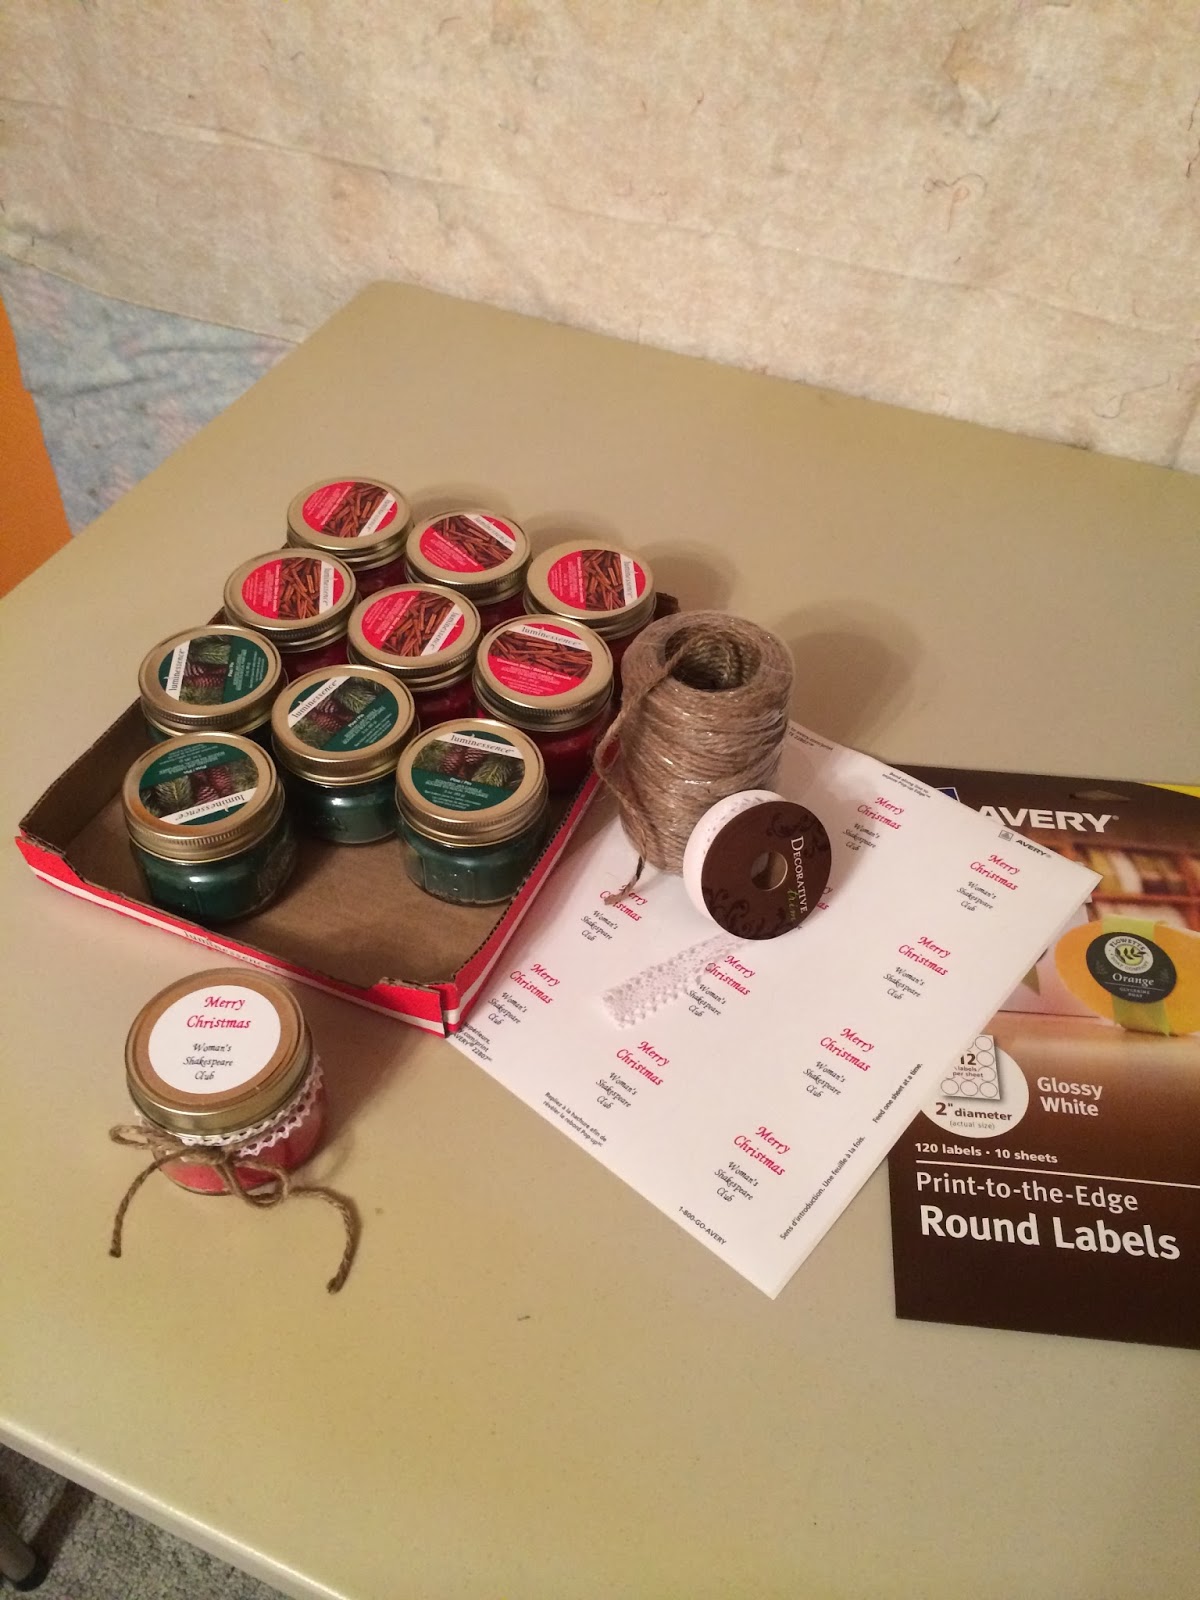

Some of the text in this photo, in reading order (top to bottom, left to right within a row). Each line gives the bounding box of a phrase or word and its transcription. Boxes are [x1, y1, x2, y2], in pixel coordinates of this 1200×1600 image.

[168, 648, 186, 691] luminessence
[291, 679, 337, 718] luminessence
[450, 734, 514, 753] luminessence
[874, 796, 905, 815] Merry
[857, 804, 902, 830] Christmas
[842, 828, 877, 849] Shakespeare
[853, 823, 880, 839] Woman's
[845, 841, 861, 851] Club
[988, 854, 1020, 875] Merry
[970, 861, 1018, 891] Christmas
[956, 887, 994, 910] Shakespeare
[967, 881, 997, 899] Woman's
[960, 900, 976, 912] Club
[580, 915, 613, 941] Shakespeare
[593, 910, 618, 930] Woman's
[581, 929, 596, 942] Club
[917, 936, 951, 958] Merry
[724, 955, 756, 979] Merry
[898, 944, 948, 976] Christmas
[530, 963, 560, 987] Merry
[704, 962, 751, 996] Christmas
[883, 973, 921, 998] Shakespeare
[895, 966, 925, 986] Woman's
[1112, 972, 1155, 987] Orange
[509, 970, 554, 1005] Christmas
[699, 984, 727, 1005] Woman's
[887, 988, 904, 1000] Club
[204, 996, 245, 1011] Merry
[487, 998, 521, 1025] Shakespeare
[501, 992, 528, 1014] Woman's
[686, 990, 722, 1016] Shakespeare
[688, 1004, 703, 1017] Club
[186, 1015, 251, 1029] Christmas
[488, 1012, 504, 1025] Club
[193, 1043, 232, 1052] Woman's
[840, 1028, 875, 1052] Merry
[182, 1057, 233, 1067] Shakespeare
[637, 1041, 670, 1067] Merry
[820, 1037, 871, 1072] Christmas
[194, 1070, 215, 1081] Club
[616, 1048, 664, 1086] Christmas
[815, 1061, 846, 1083] Woman's
[609, 1072, 638, 1096] Woman's
[802, 1068, 842, 1096] Shakespeare
[806, 1084, 824, 1098] Club
[1036, 1076, 1103, 1100] Glossy
[595, 1079, 632, 1109] Shakespeare
[596, 1095, 614, 1110] Club
[872, 1108, 886, 1124] Feed
[883, 1099, 894, 1111] one
[891, 1085, 905, 1100] sheet
[902, 1078, 910, 1086] at
[909, 1063, 923, 1076] time.
[954, 1108, 1013, 1121] diameter
[1040, 1096, 1100, 1117] White
[589, 1127, 600, 1136] afin
[949, 1120, 996, 1130] (actual size)
[755, 1126, 790, 1154] Merry
[734, 1135, 786, 1176] Christmas
[915, 1142, 1059, 1164] 120 labels 10 sheets
[714, 1168, 754, 1200] Shakespeare
[728, 1161, 759, 1187] Woman's
[716, 1187, 733, 1202] Club
[779, 1225, 794, 1240] Sens
[791, 1187, 826, 1227] d'introduction.
[821, 1174, 835, 1188] Une
[831, 1157, 848, 1176] feuille
[847, 1147, 856, 1155] la
[852, 1136, 866, 1149] fois.
[916, 1171, 1139, 1215] Print-to-the-Edge
[678, 1205, 727, 1245] 1-800-GO-AVERY
[920, 1204, 1182, 1261] Round Labels
